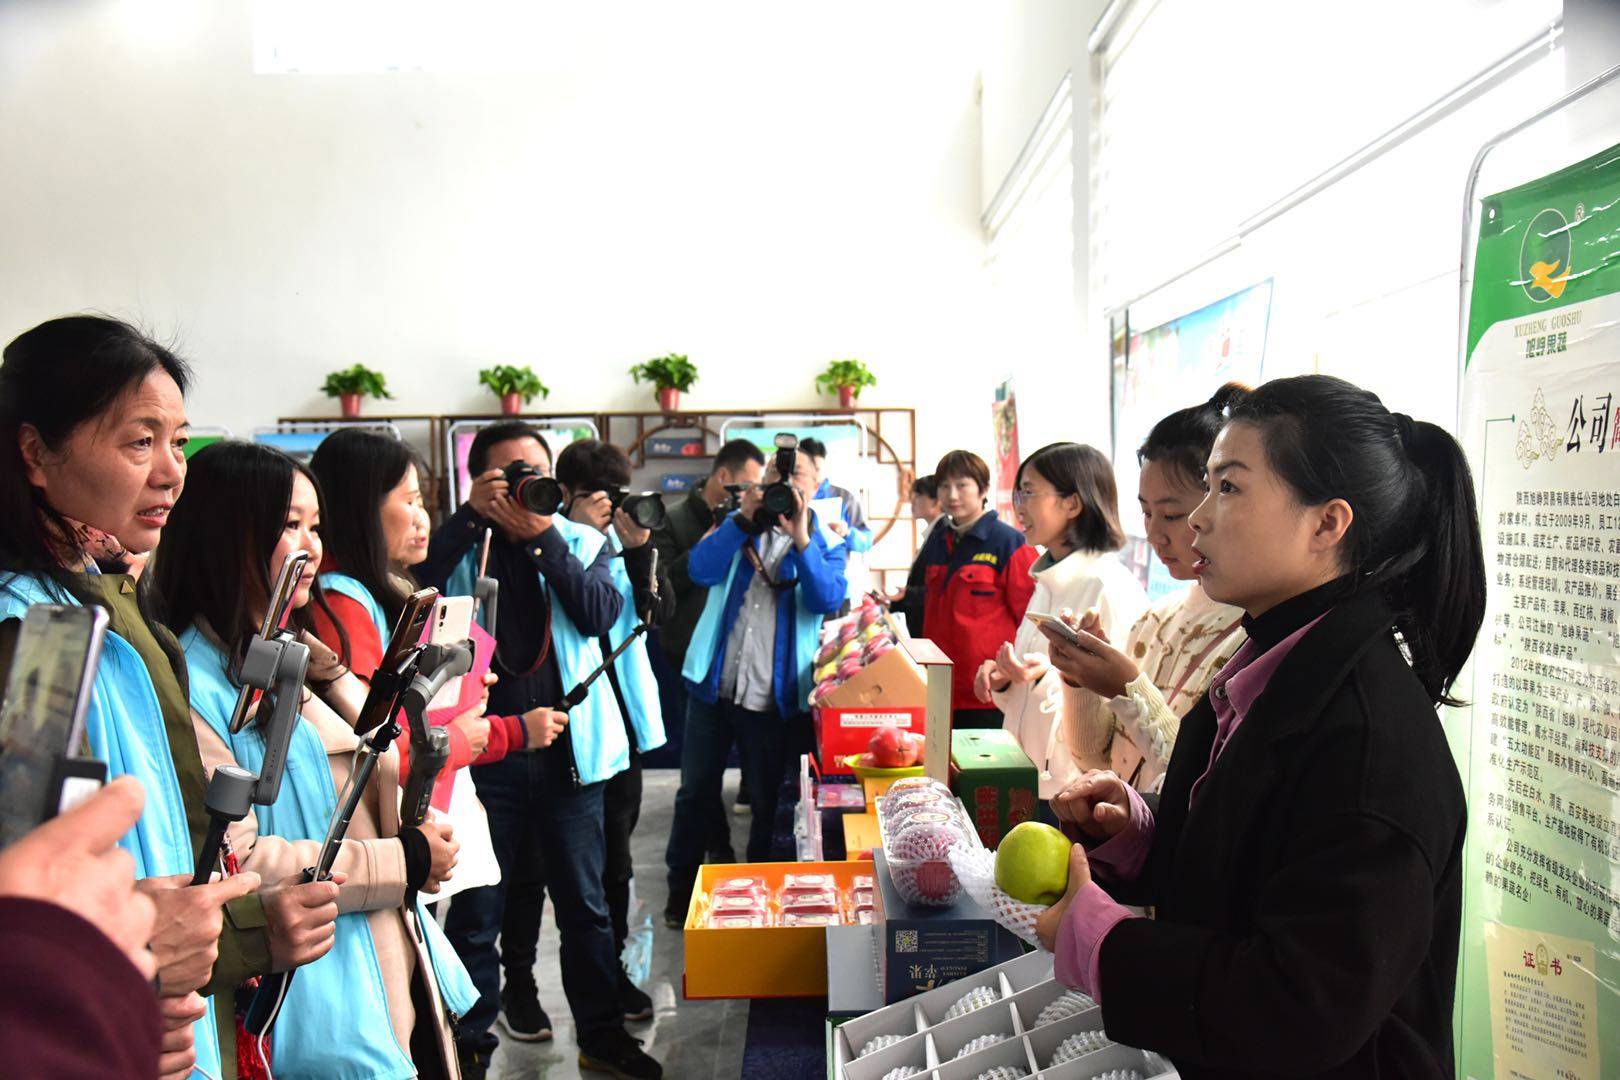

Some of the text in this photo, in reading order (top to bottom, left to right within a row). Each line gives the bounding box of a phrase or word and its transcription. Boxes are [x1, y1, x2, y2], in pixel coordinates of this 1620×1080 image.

[1514, 309, 1583, 338] XUZHENG GUOSHU
[1523, 950, 1535, 968] 证
[1550, 957, 1562, 976] 书
